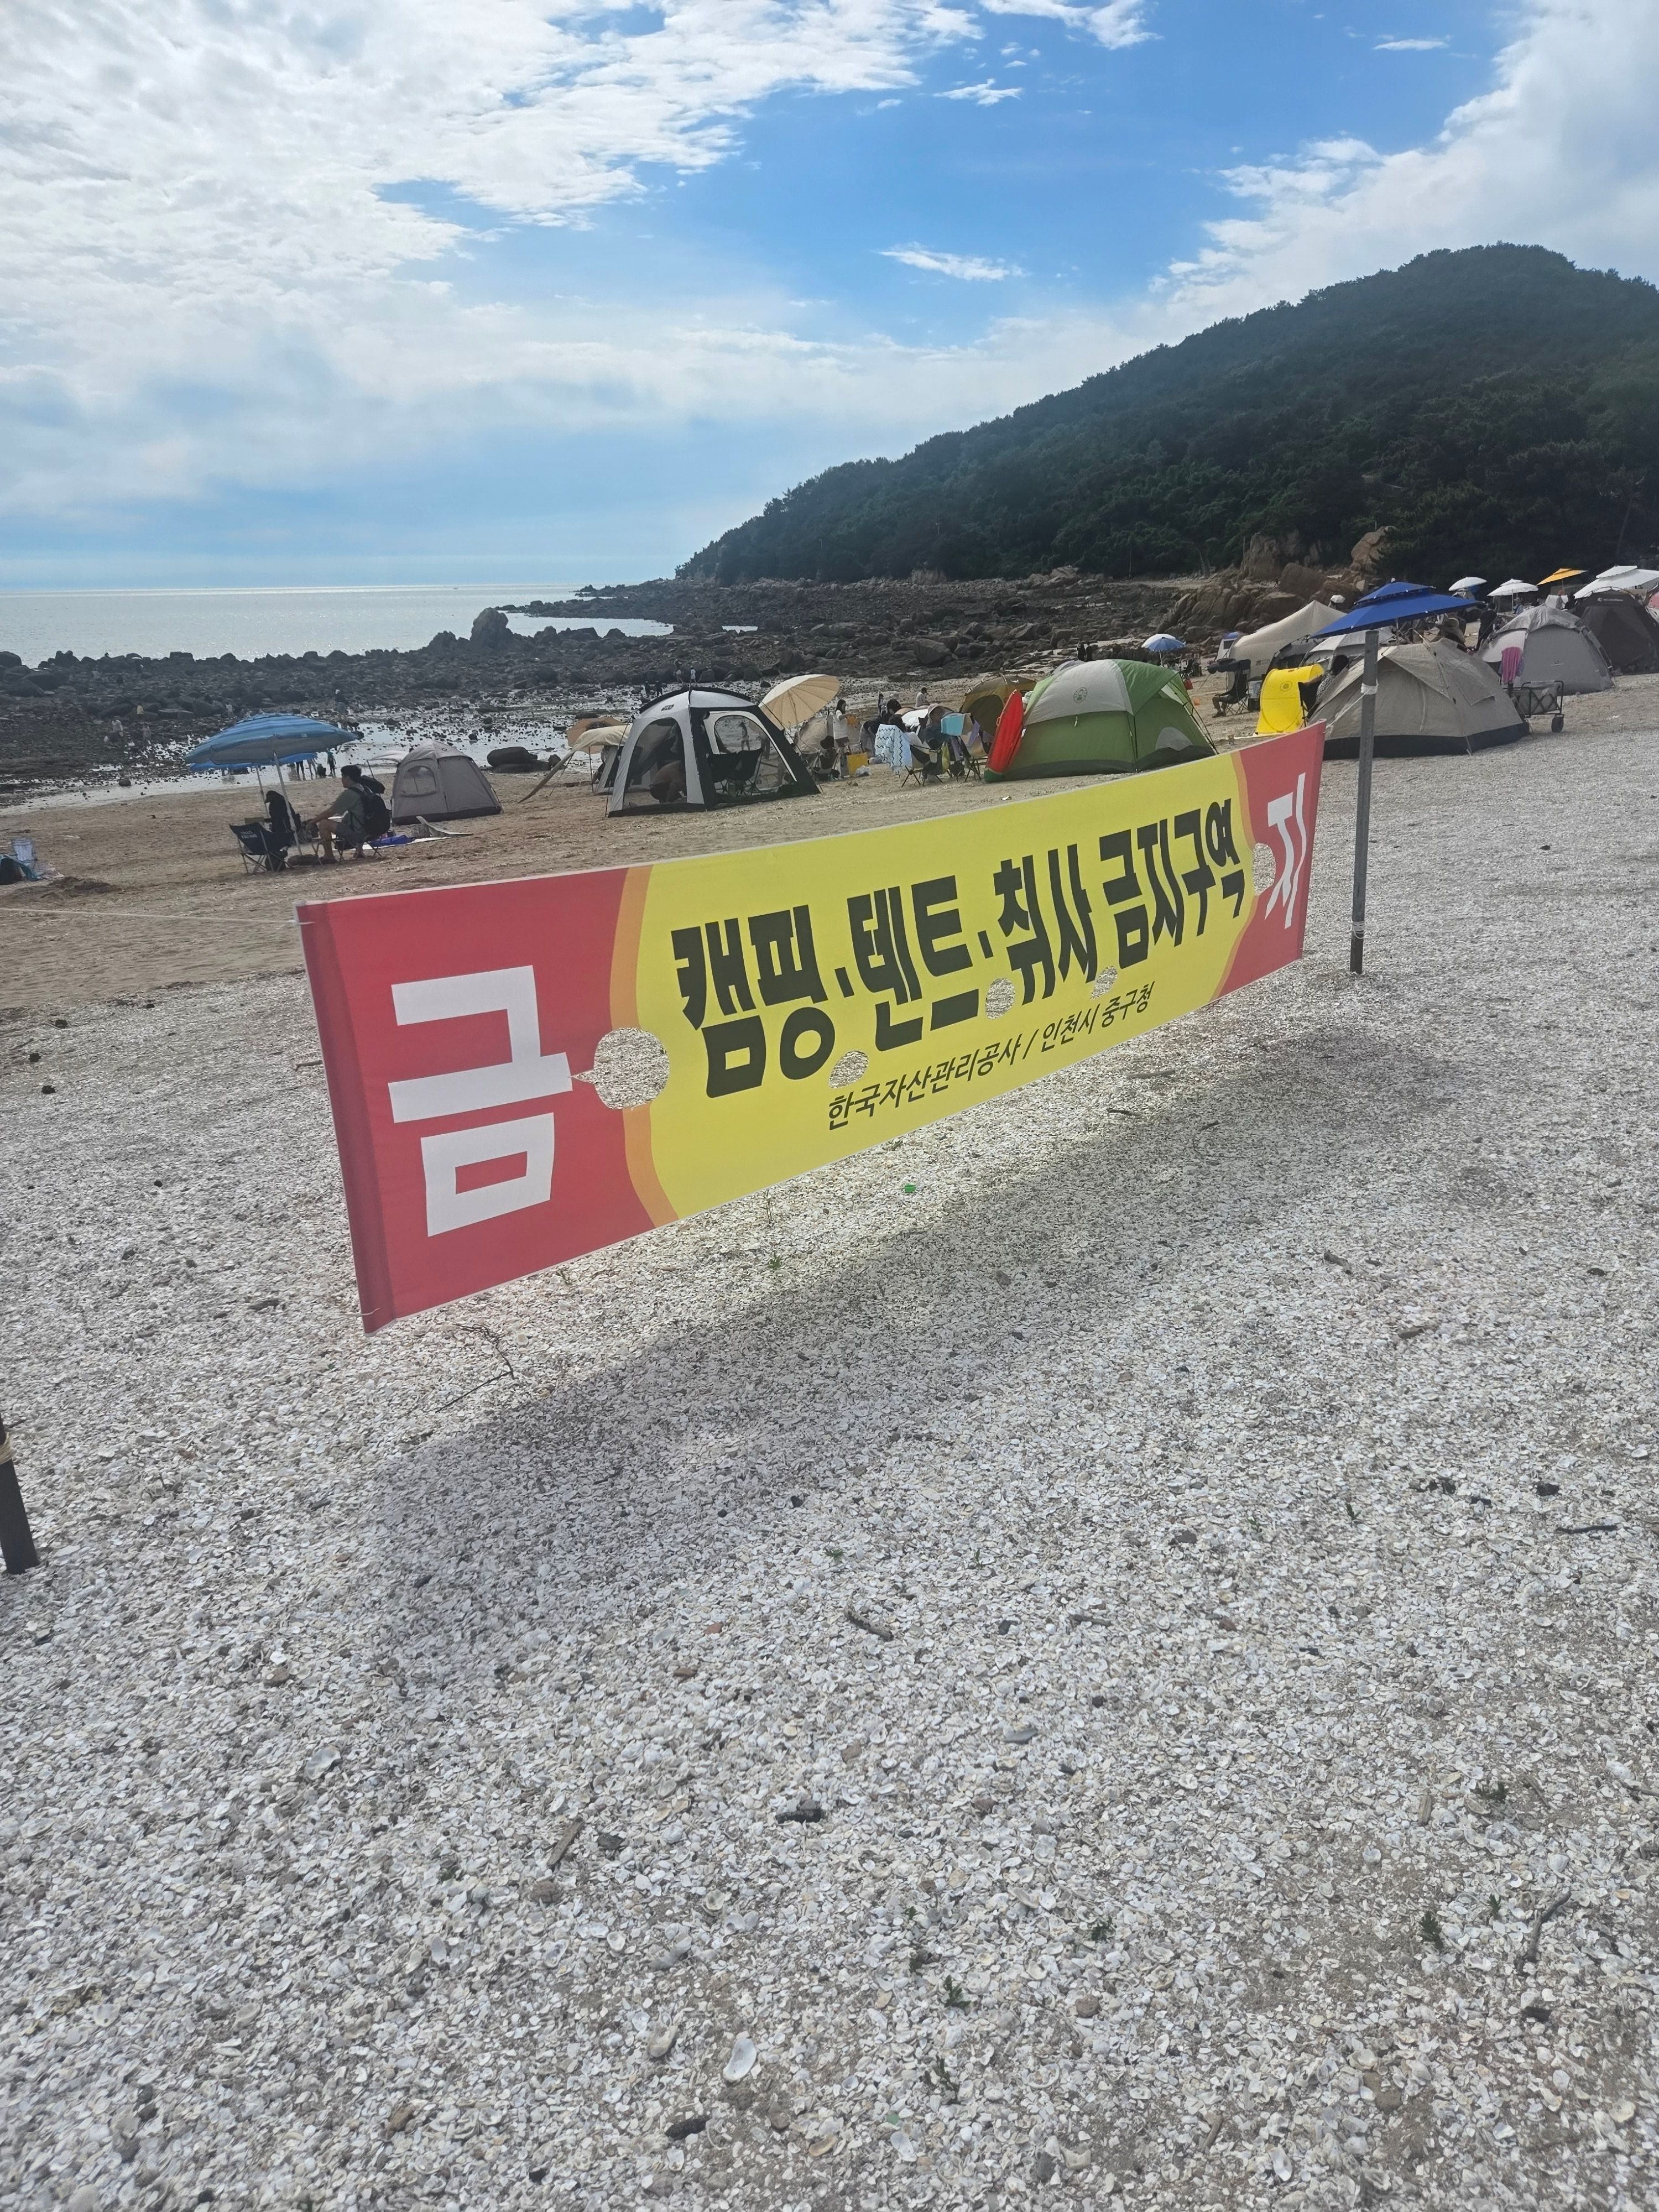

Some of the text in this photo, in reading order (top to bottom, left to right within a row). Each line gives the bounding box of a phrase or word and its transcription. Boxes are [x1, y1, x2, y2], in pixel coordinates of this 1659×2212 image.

[1099, 798, 1245, 969] 금지구역
[1265, 773, 1306, 929] 지
[388, 965, 573, 1237] 금
[828, 981, 1155, 1130] 한국자산관리공사 / 인천시 중구청
